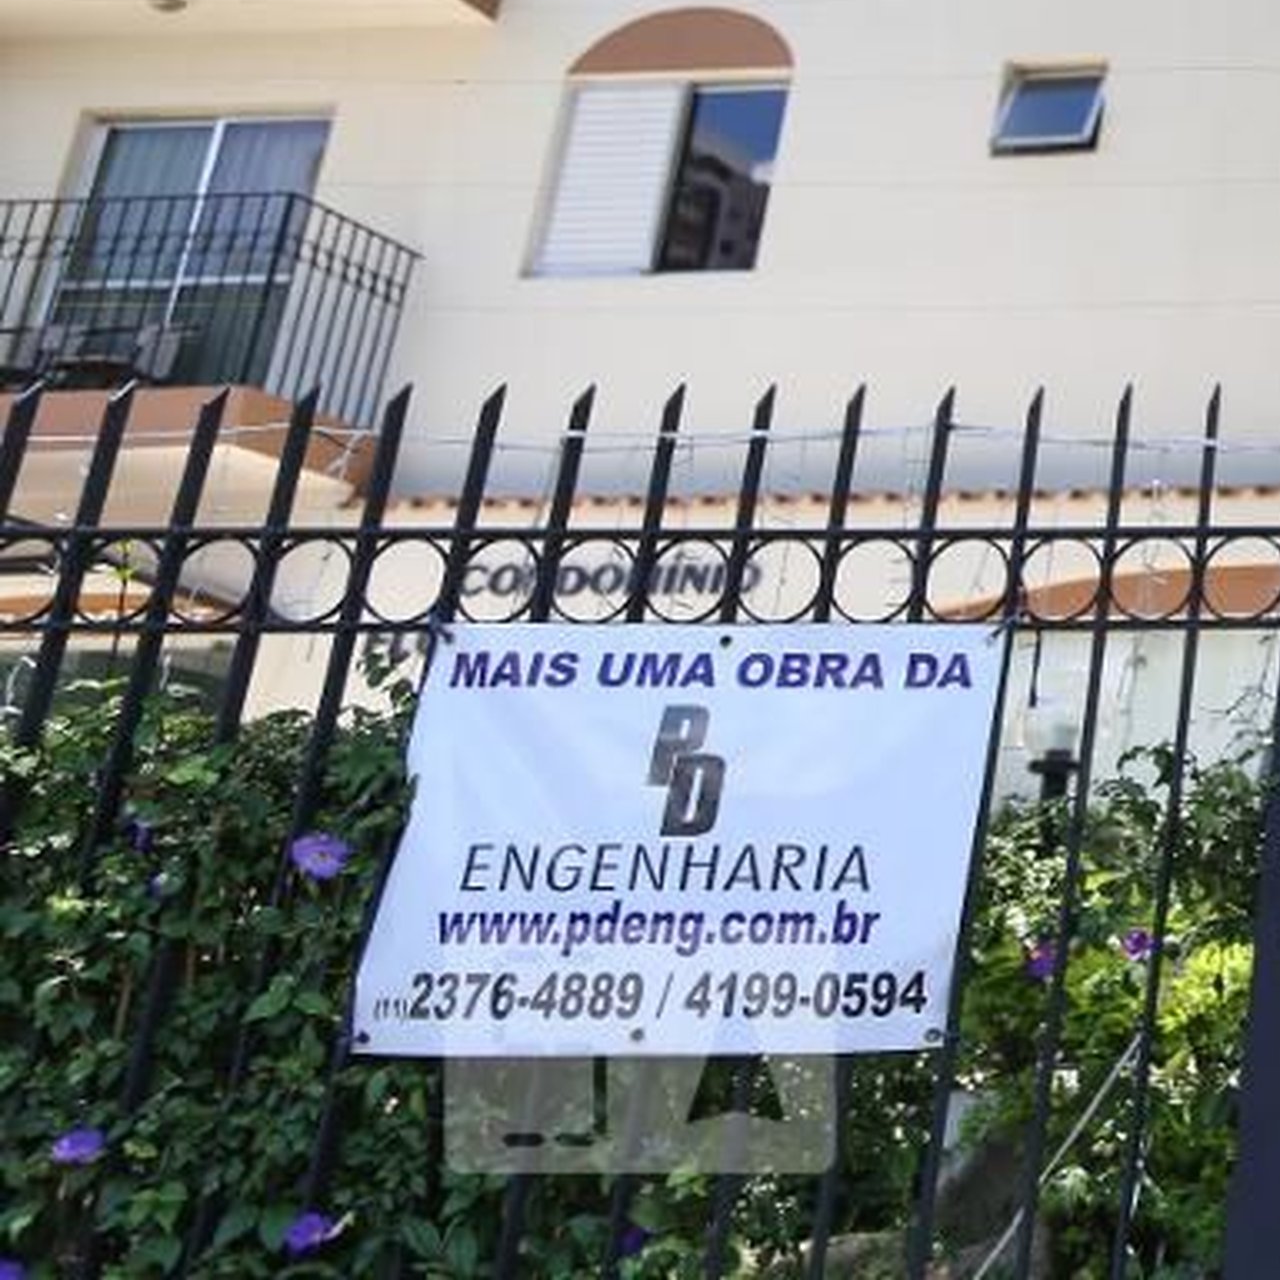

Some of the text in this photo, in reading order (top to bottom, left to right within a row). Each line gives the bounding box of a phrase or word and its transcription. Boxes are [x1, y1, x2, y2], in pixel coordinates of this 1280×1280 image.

[449, 653, 973, 688] MAIS UMA OBRA DA
[459, 844, 871, 893] ENGENHARIA
[438, 901, 880, 956] www.pdeng.com.br
[411, 972, 644, 1019] 2376-4889
[684, 972, 926, 1018] 4199-0594
